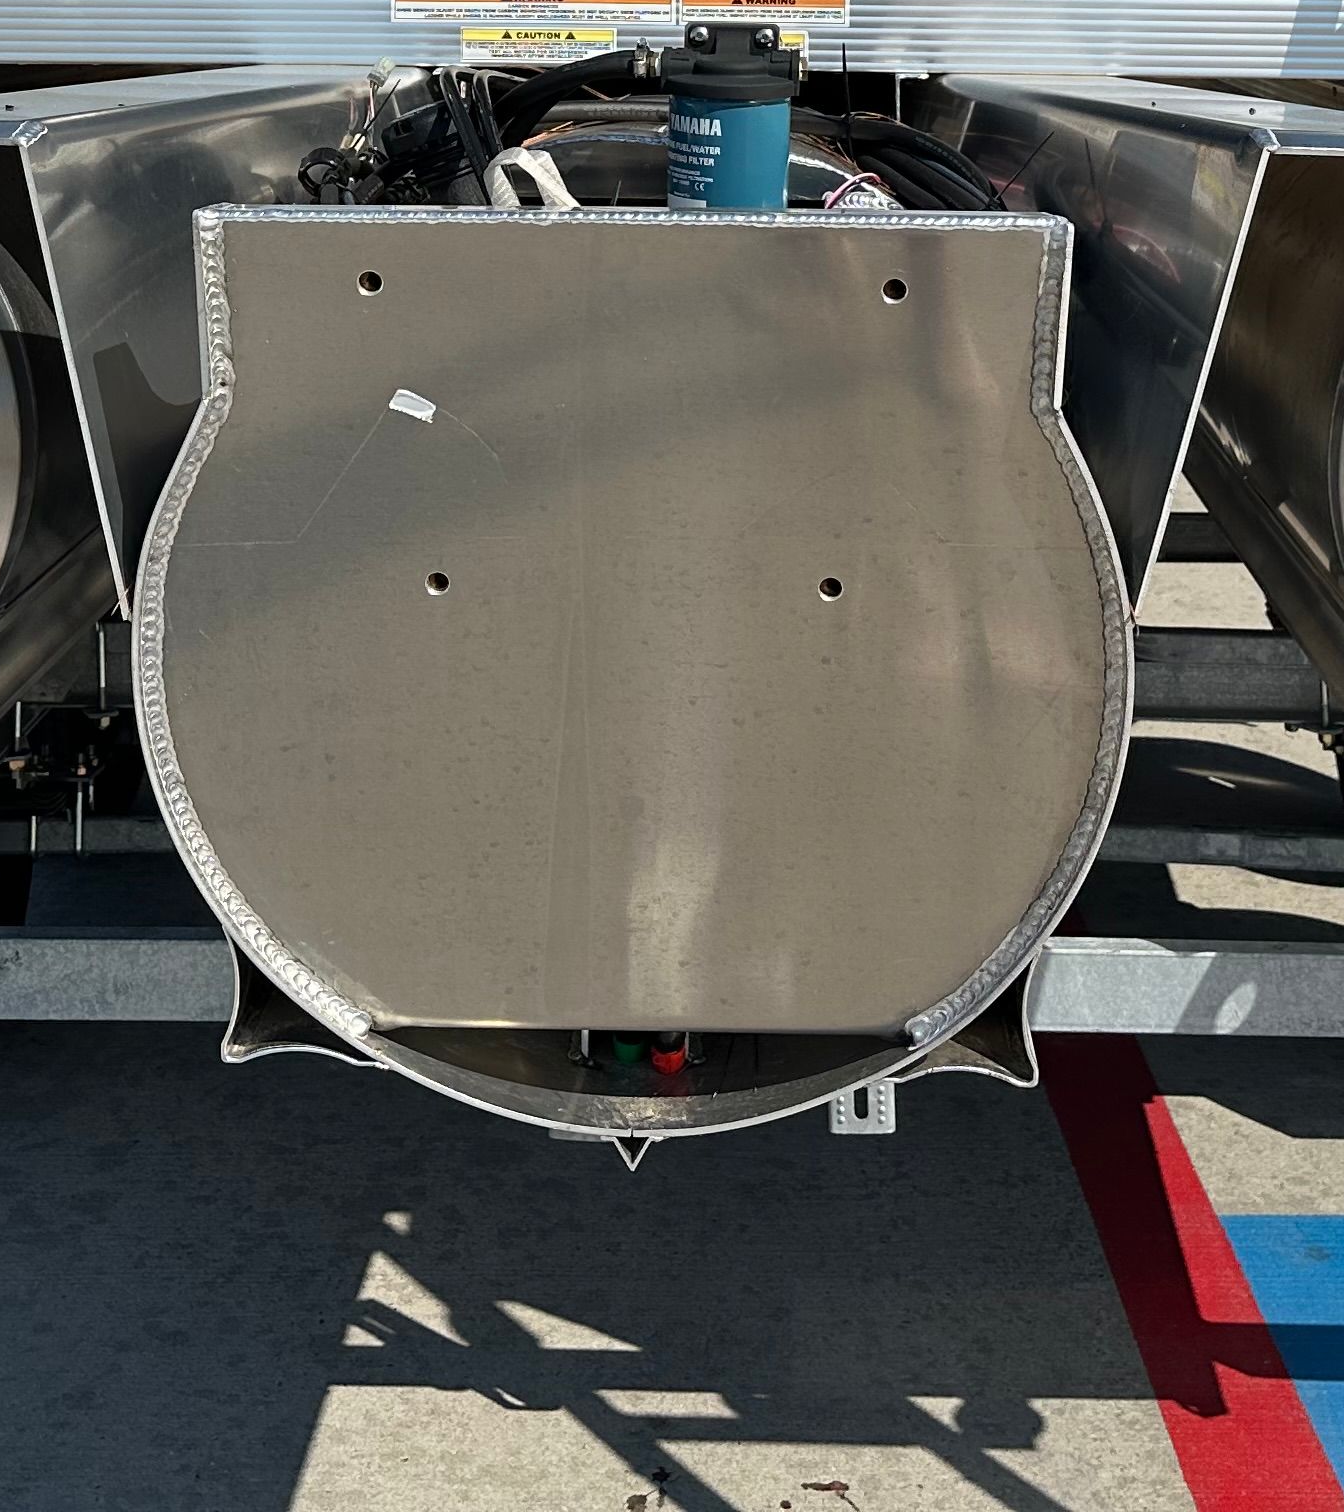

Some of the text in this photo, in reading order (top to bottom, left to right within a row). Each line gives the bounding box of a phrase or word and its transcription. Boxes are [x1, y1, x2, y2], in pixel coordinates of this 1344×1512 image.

[516, 31, 562, 41] CAUTION
[671, 113, 722, 137] YAMAHA
[688, 155, 715, 167] FILTER
